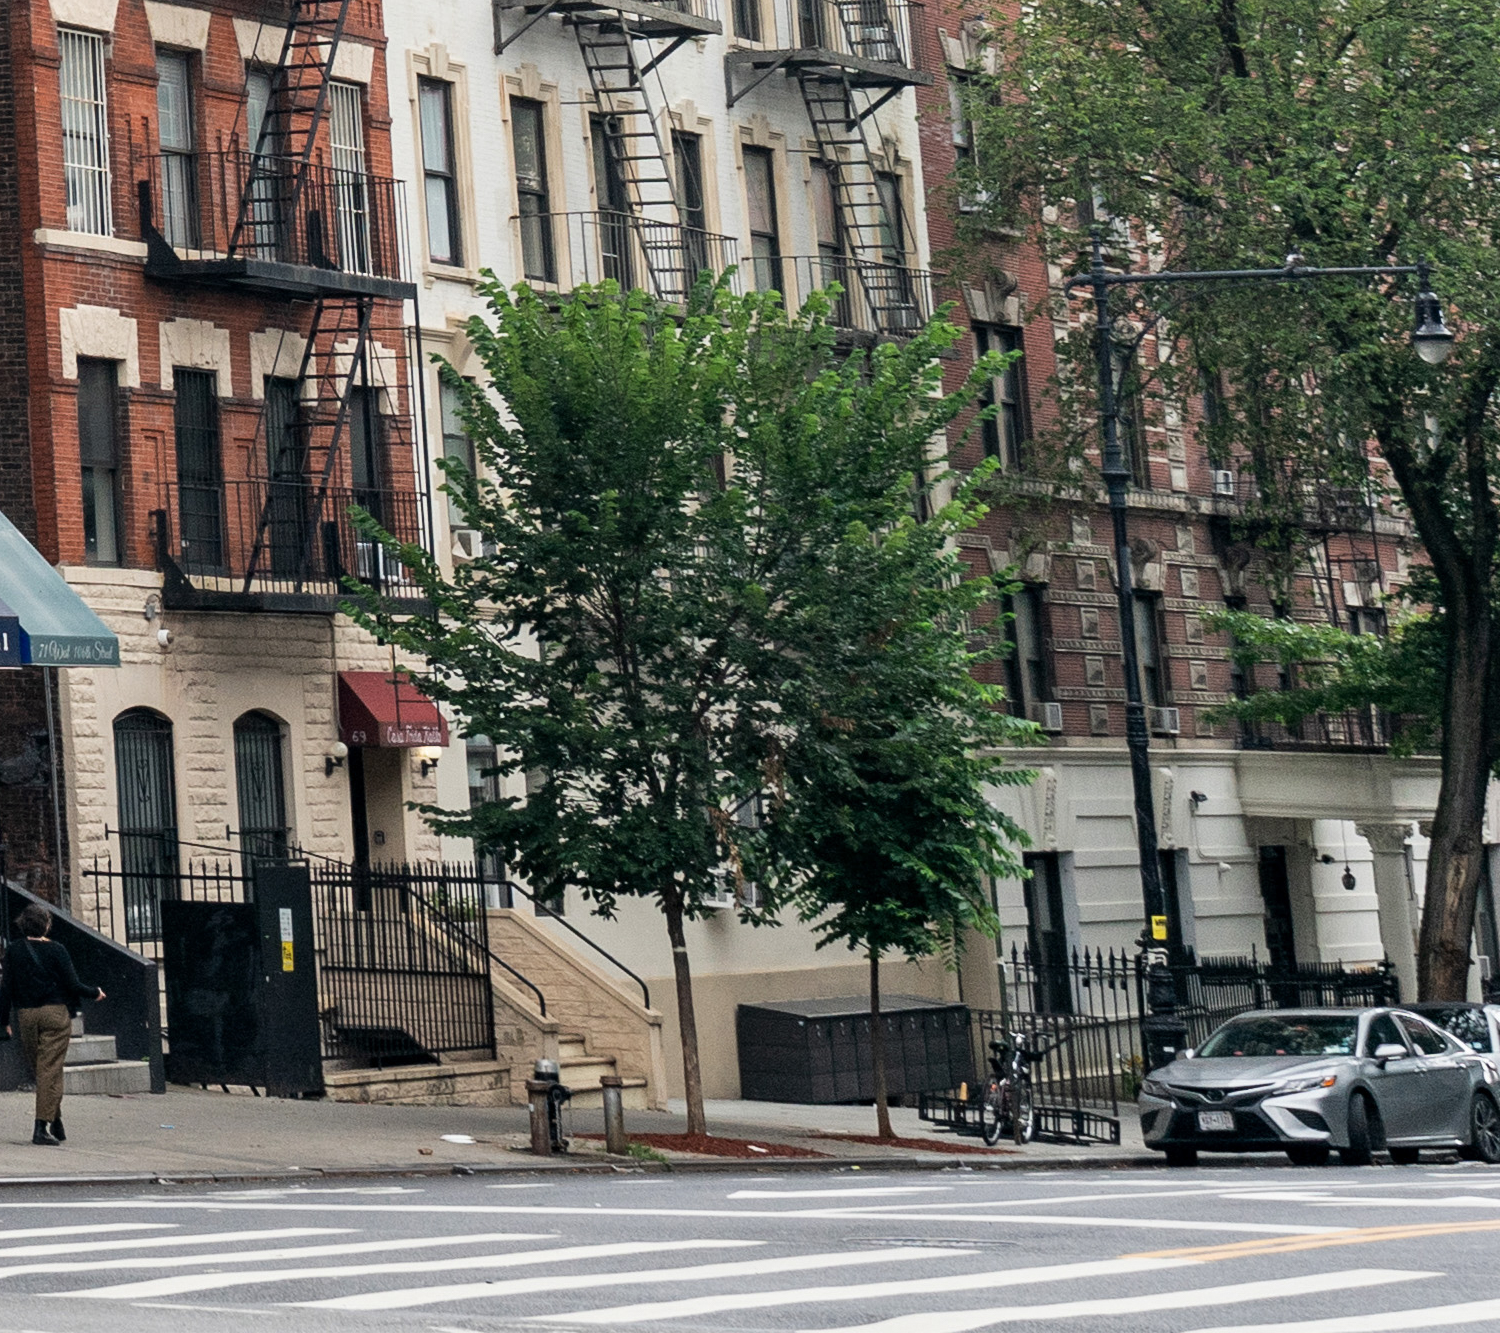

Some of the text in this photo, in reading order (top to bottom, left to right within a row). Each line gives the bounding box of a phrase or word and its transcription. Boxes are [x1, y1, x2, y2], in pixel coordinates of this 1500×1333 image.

[38, 640, 113, 661] 71 West 106th Street
[352, 730, 366, 743] 69
